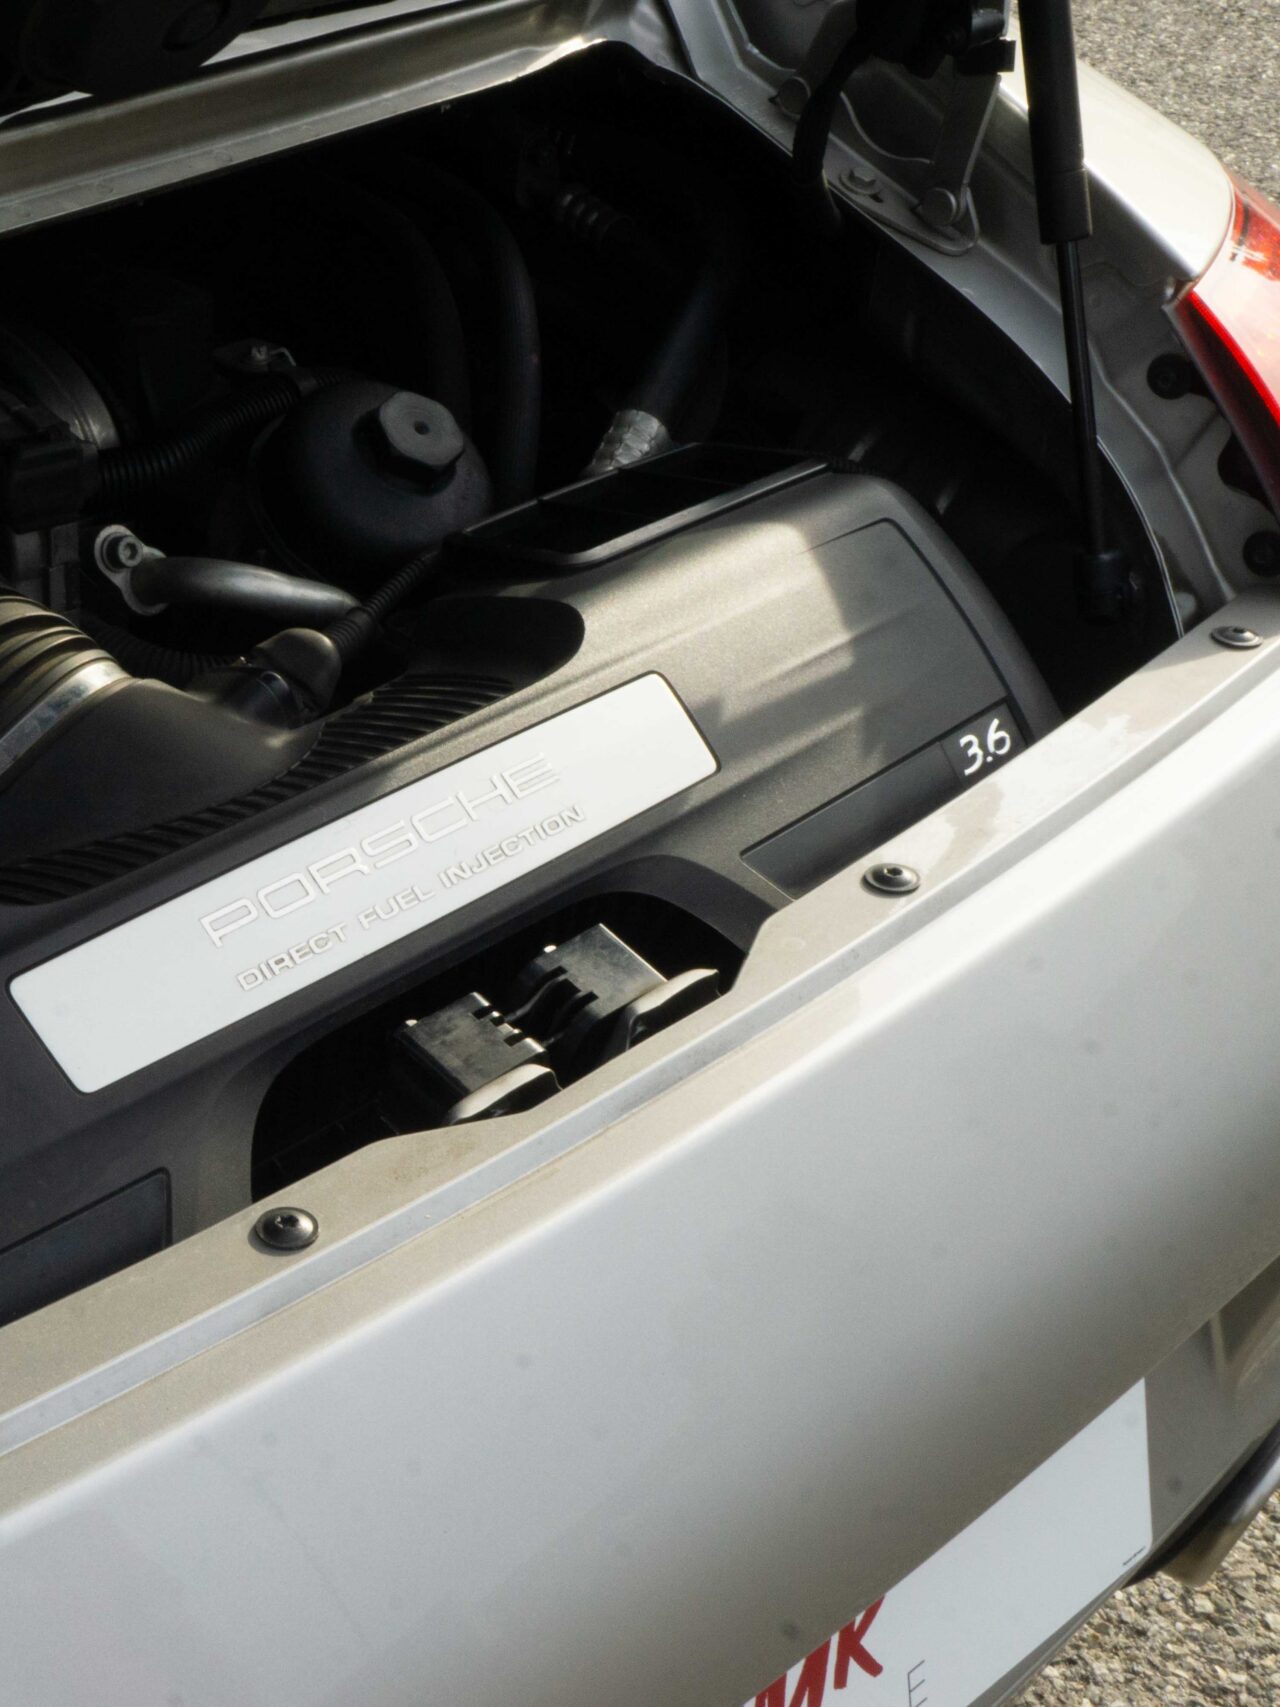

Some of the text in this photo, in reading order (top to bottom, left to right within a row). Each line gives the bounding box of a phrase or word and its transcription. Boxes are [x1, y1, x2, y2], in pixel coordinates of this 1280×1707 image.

[959, 717, 1012, 777] 3.6
[199, 751, 562, 948] PORSCHE
[235, 804, 588, 992] DIRECT FUEL INJECTION
